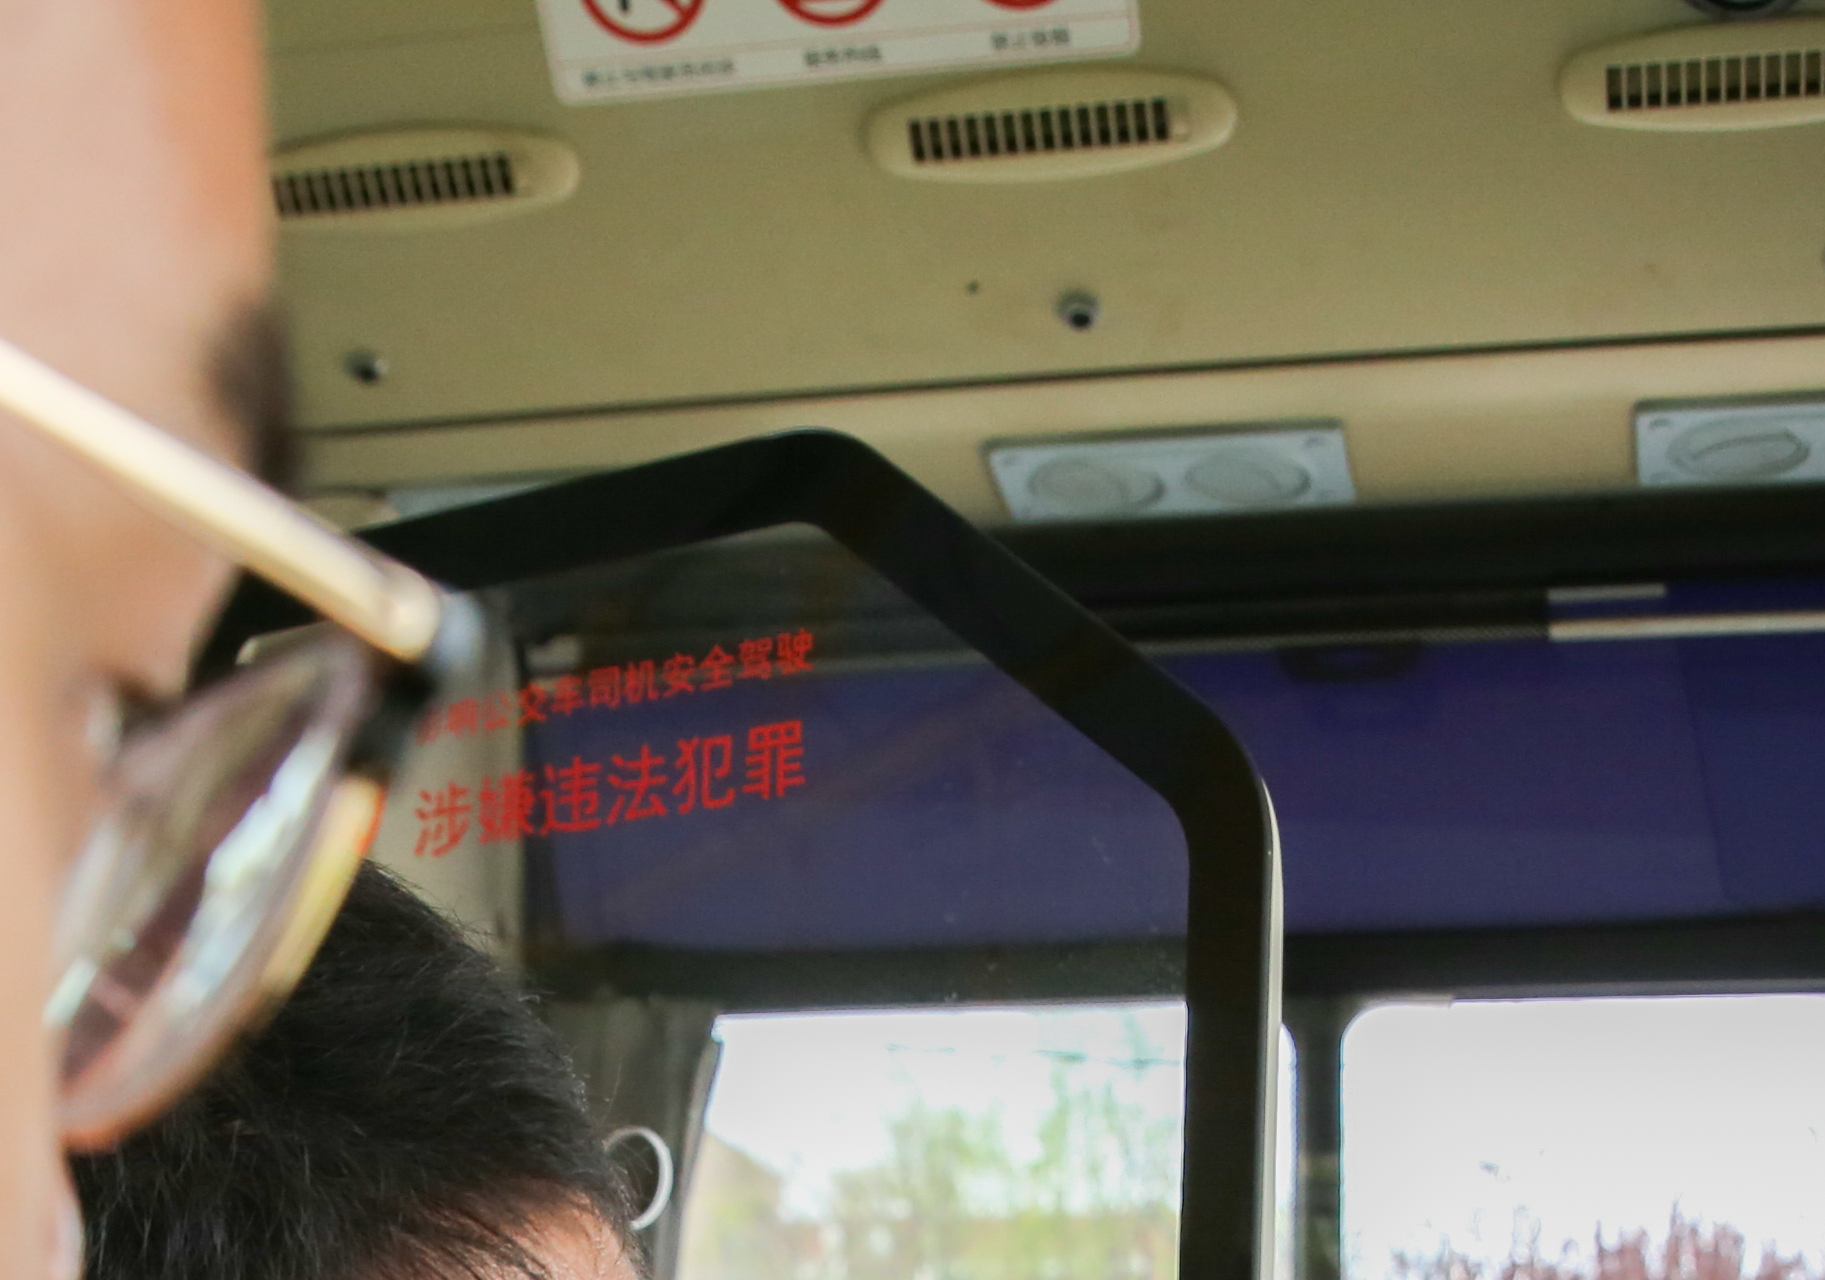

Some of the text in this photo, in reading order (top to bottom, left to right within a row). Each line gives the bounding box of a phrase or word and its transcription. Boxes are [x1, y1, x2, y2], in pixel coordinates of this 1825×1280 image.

[414, 719, 807, 858] 涉嫌违法犯罪
